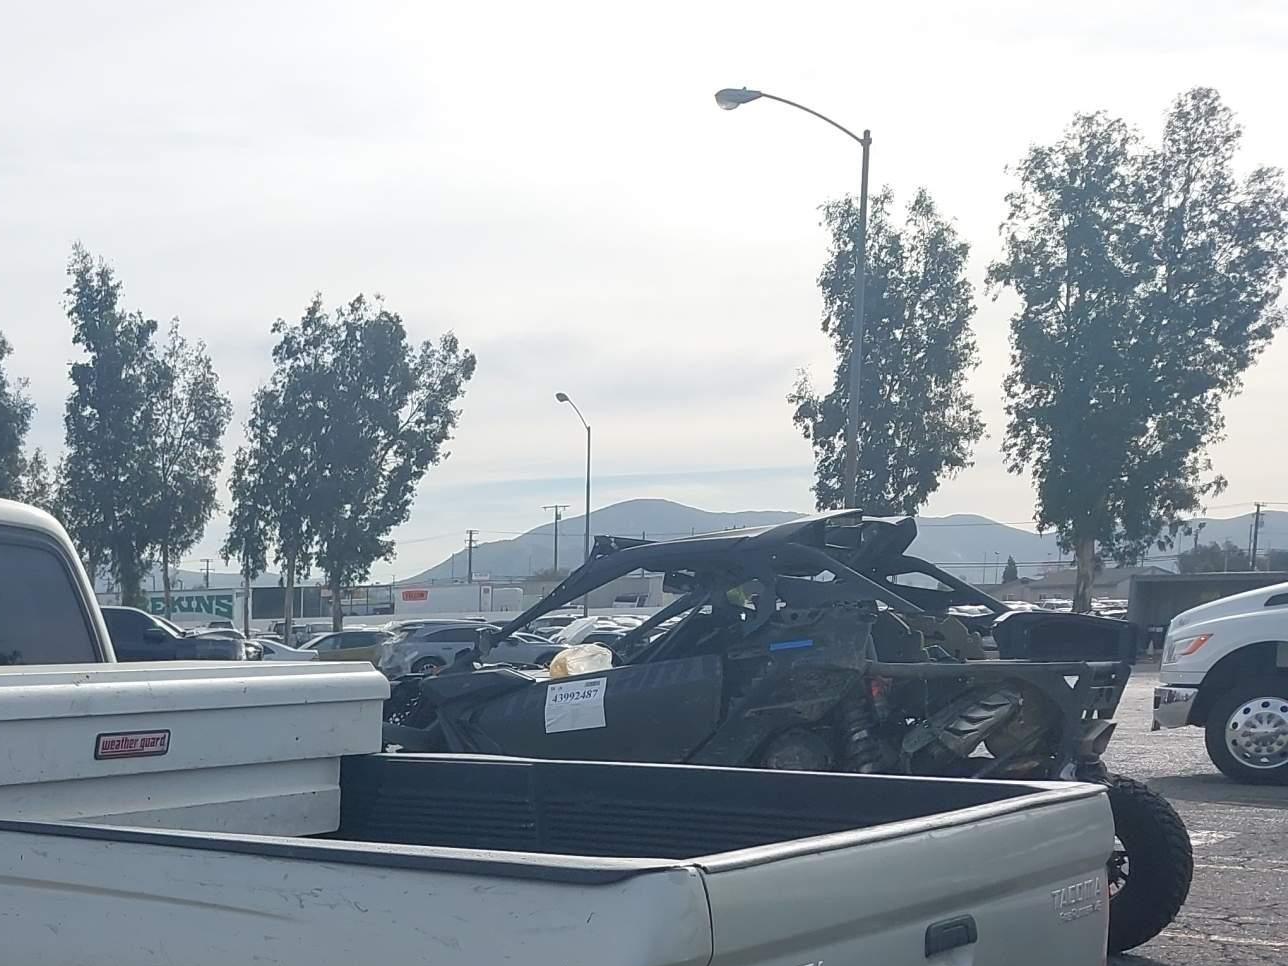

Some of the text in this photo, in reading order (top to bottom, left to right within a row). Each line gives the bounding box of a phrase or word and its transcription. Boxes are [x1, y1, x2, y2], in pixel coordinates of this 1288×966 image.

[140, 594, 233, 620] EKINS
[552, 688, 599, 703] 43992487
[101, 733, 167, 751] weather guard
